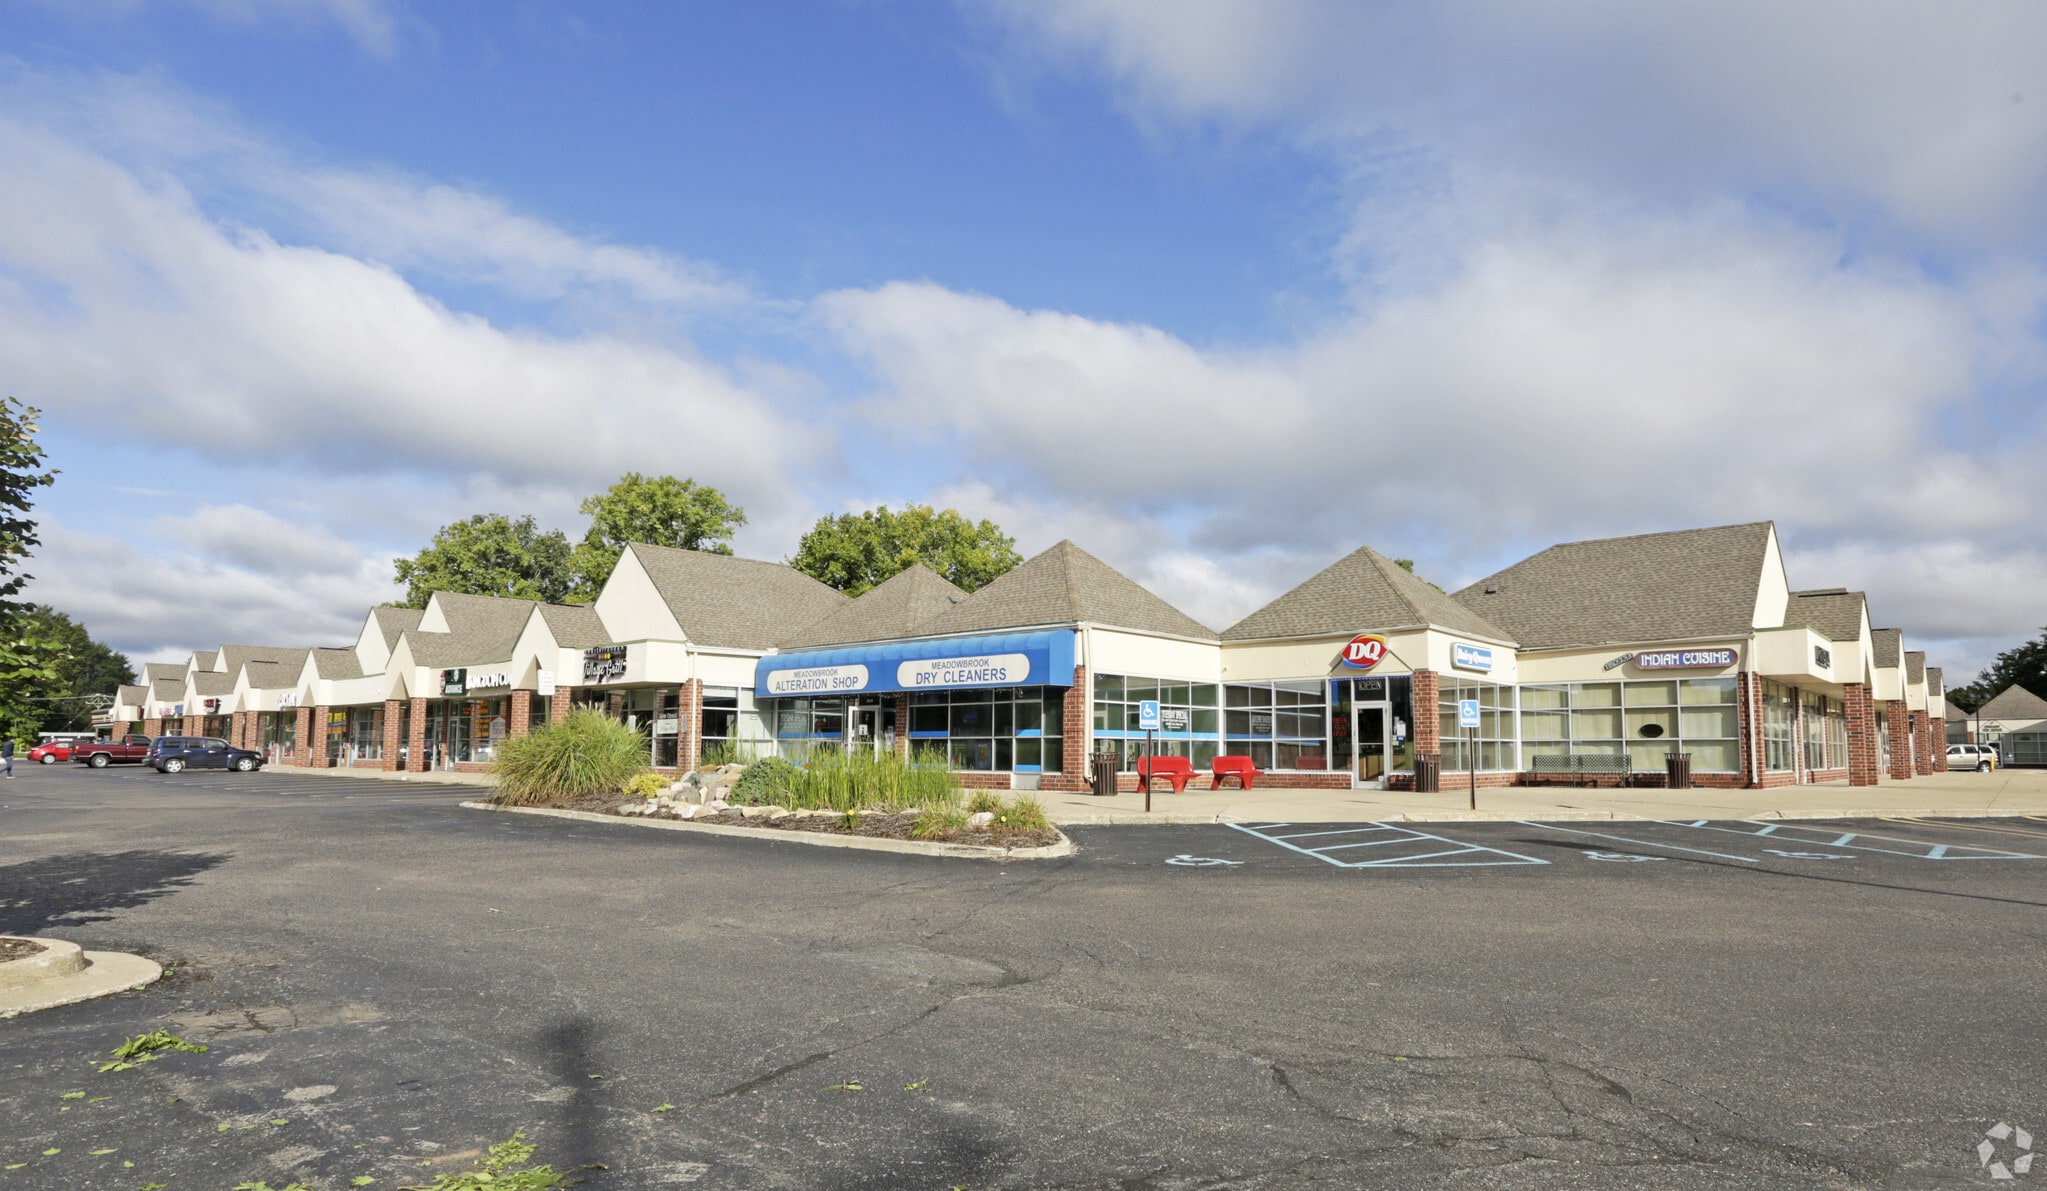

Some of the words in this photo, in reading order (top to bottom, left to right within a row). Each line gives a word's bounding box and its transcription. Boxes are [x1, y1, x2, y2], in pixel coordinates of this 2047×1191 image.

[1348, 641, 1381, 661] DQ
[1641, 653, 1680, 666] INDIAN
[1682, 651, 1730, 665] CUISINE
[931, 658, 990, 670] MEADOWBROOK
[793, 668, 838, 678] MEADOWBROOK
[916, 671, 938, 685] DRY
[943, 667, 1007, 683] CLEANERS
[775, 678, 828, 691] ALTERATION
[832, 676, 859, 689] SHOP
